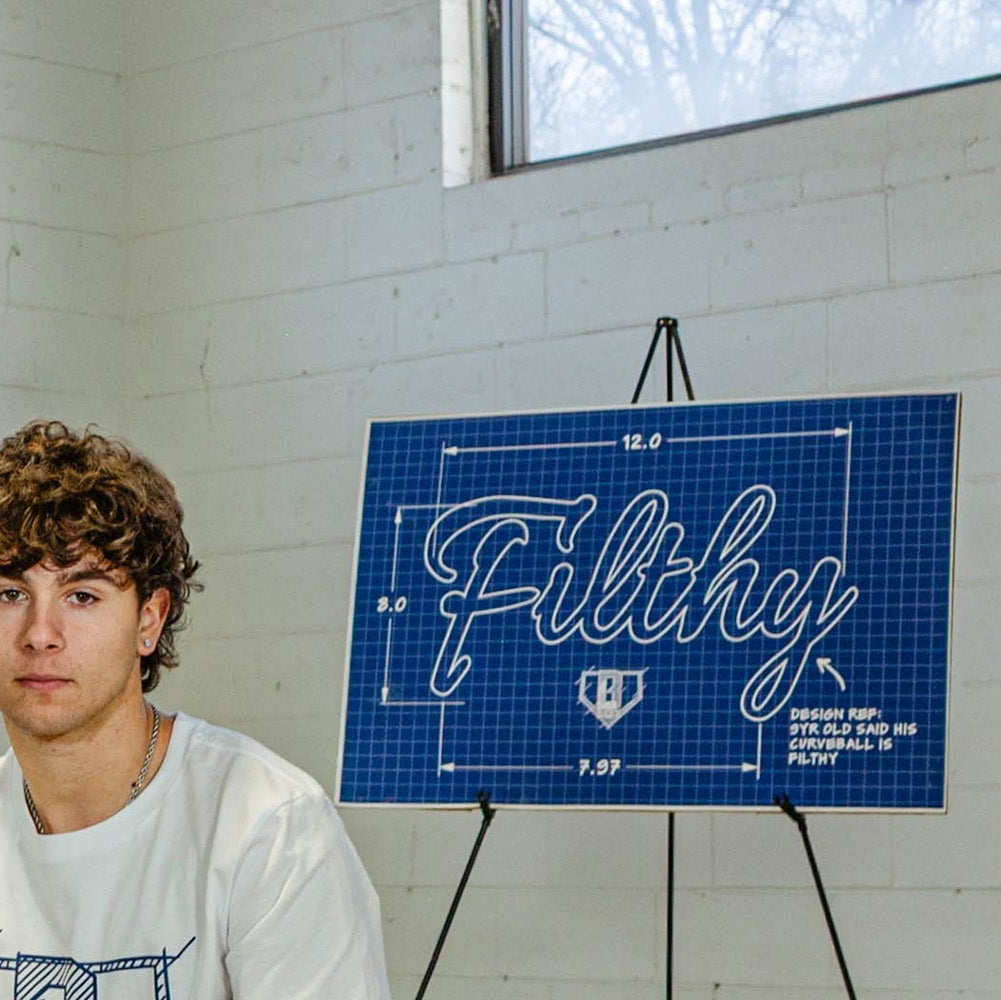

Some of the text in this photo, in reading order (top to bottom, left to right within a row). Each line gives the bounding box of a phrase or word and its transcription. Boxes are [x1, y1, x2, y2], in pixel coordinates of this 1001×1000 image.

[622, 432, 662, 451] 12.0
[423, 483, 860, 723] Filthy
[790, 707, 882, 721] DESIGN REF:
[822, 722, 852, 736] OLD
[856, 722, 889, 736] SAID
[893, 722, 918, 736] HIS
[789, 737, 893, 751] CURVEBALL IS
[788, 751, 839, 766] FILTHY
[579, 758, 621, 776] 7.97
